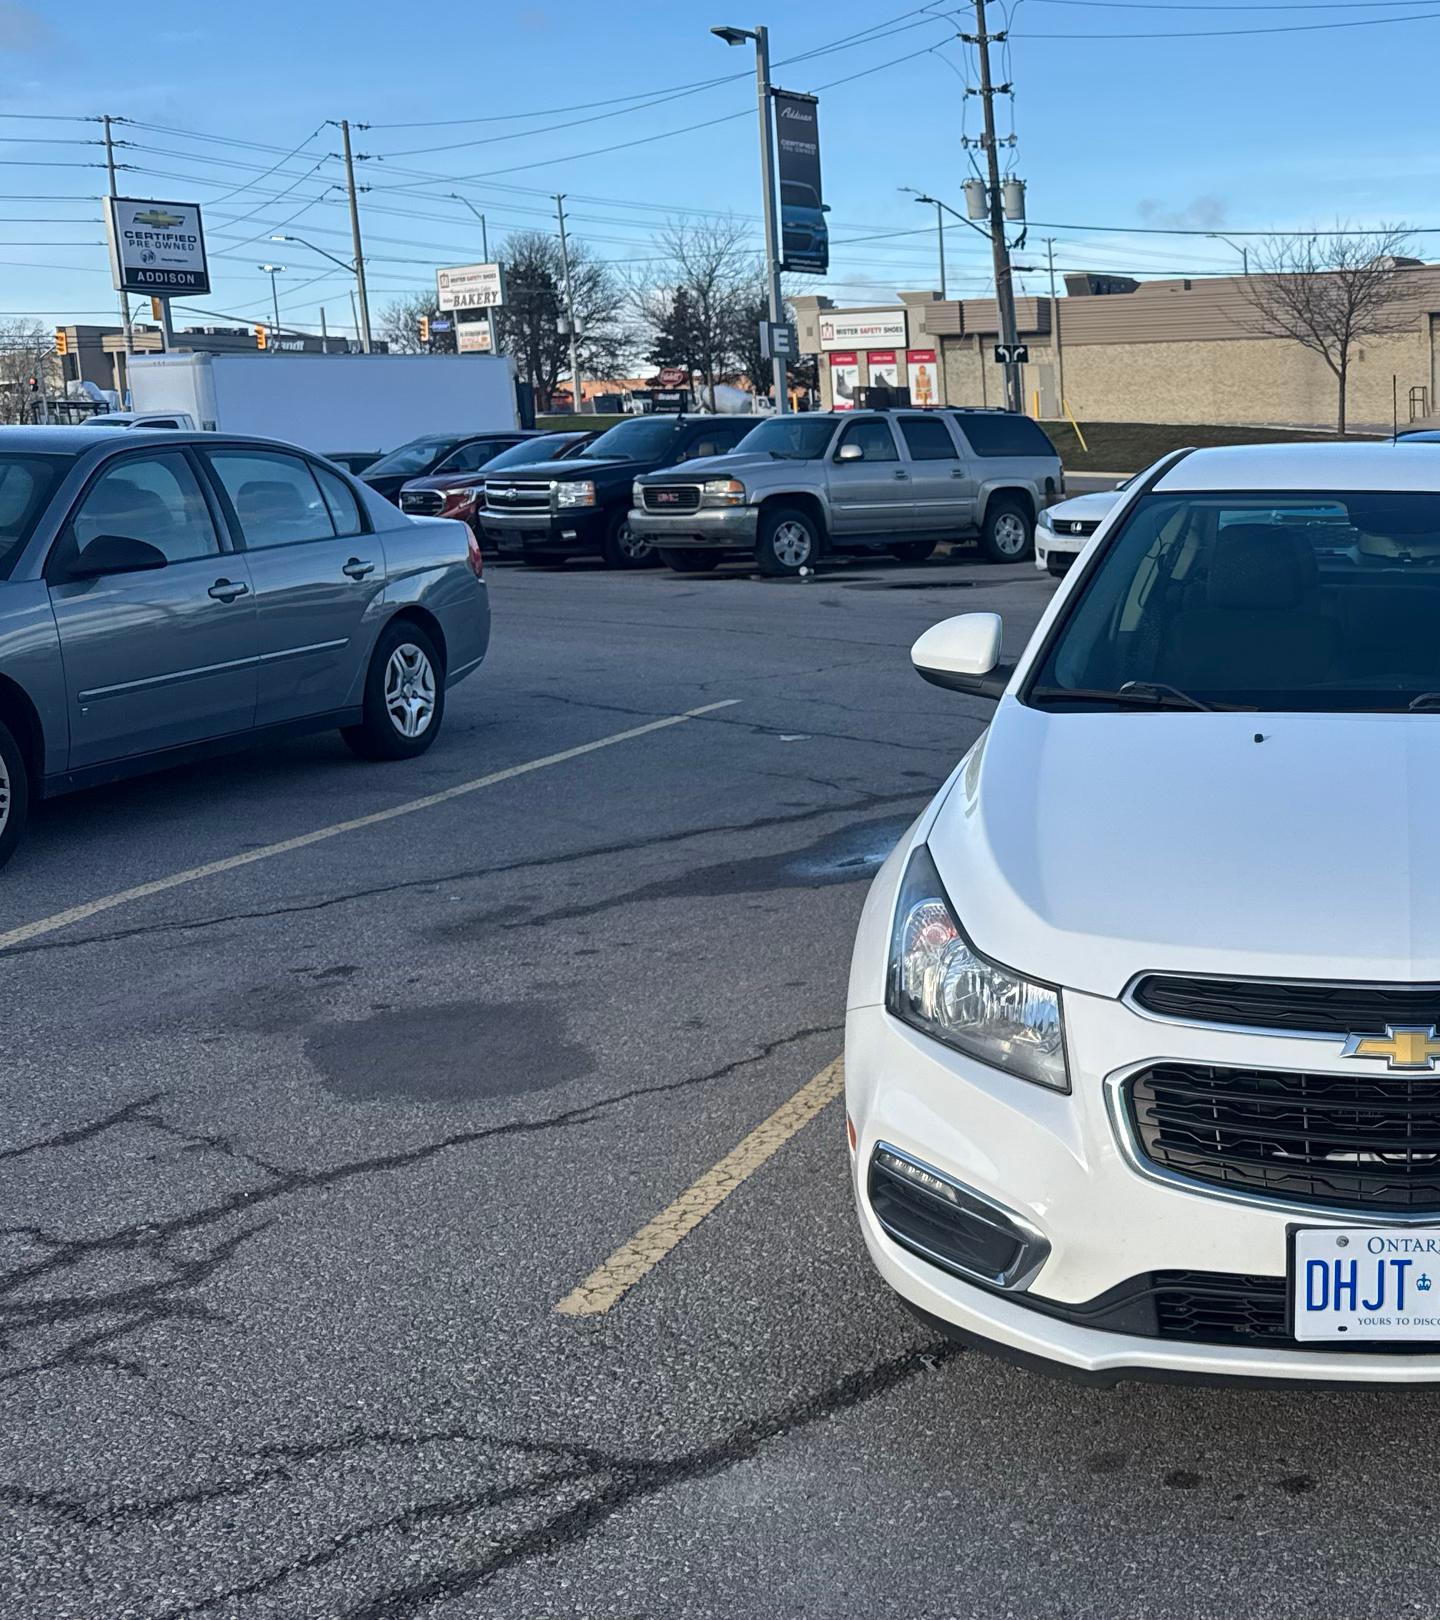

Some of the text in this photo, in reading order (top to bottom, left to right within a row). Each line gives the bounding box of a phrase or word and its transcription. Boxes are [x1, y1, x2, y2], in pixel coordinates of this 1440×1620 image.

[124, 230, 197, 243] CERTIFIED
[129, 240, 195, 251] PRE-OWNED
[137, 271, 195, 284] ADDISON
[453, 291, 499, 307] BAKERY
[836, 326, 903, 336] MISTER SAFETY SHOES
[773, 328, 790, 352] E
[1306, 1259, 1413, 1312] DHJT
[1357, 1317, 1392, 1327] YOURS
[1396, 1317, 1410, 1327] TO
